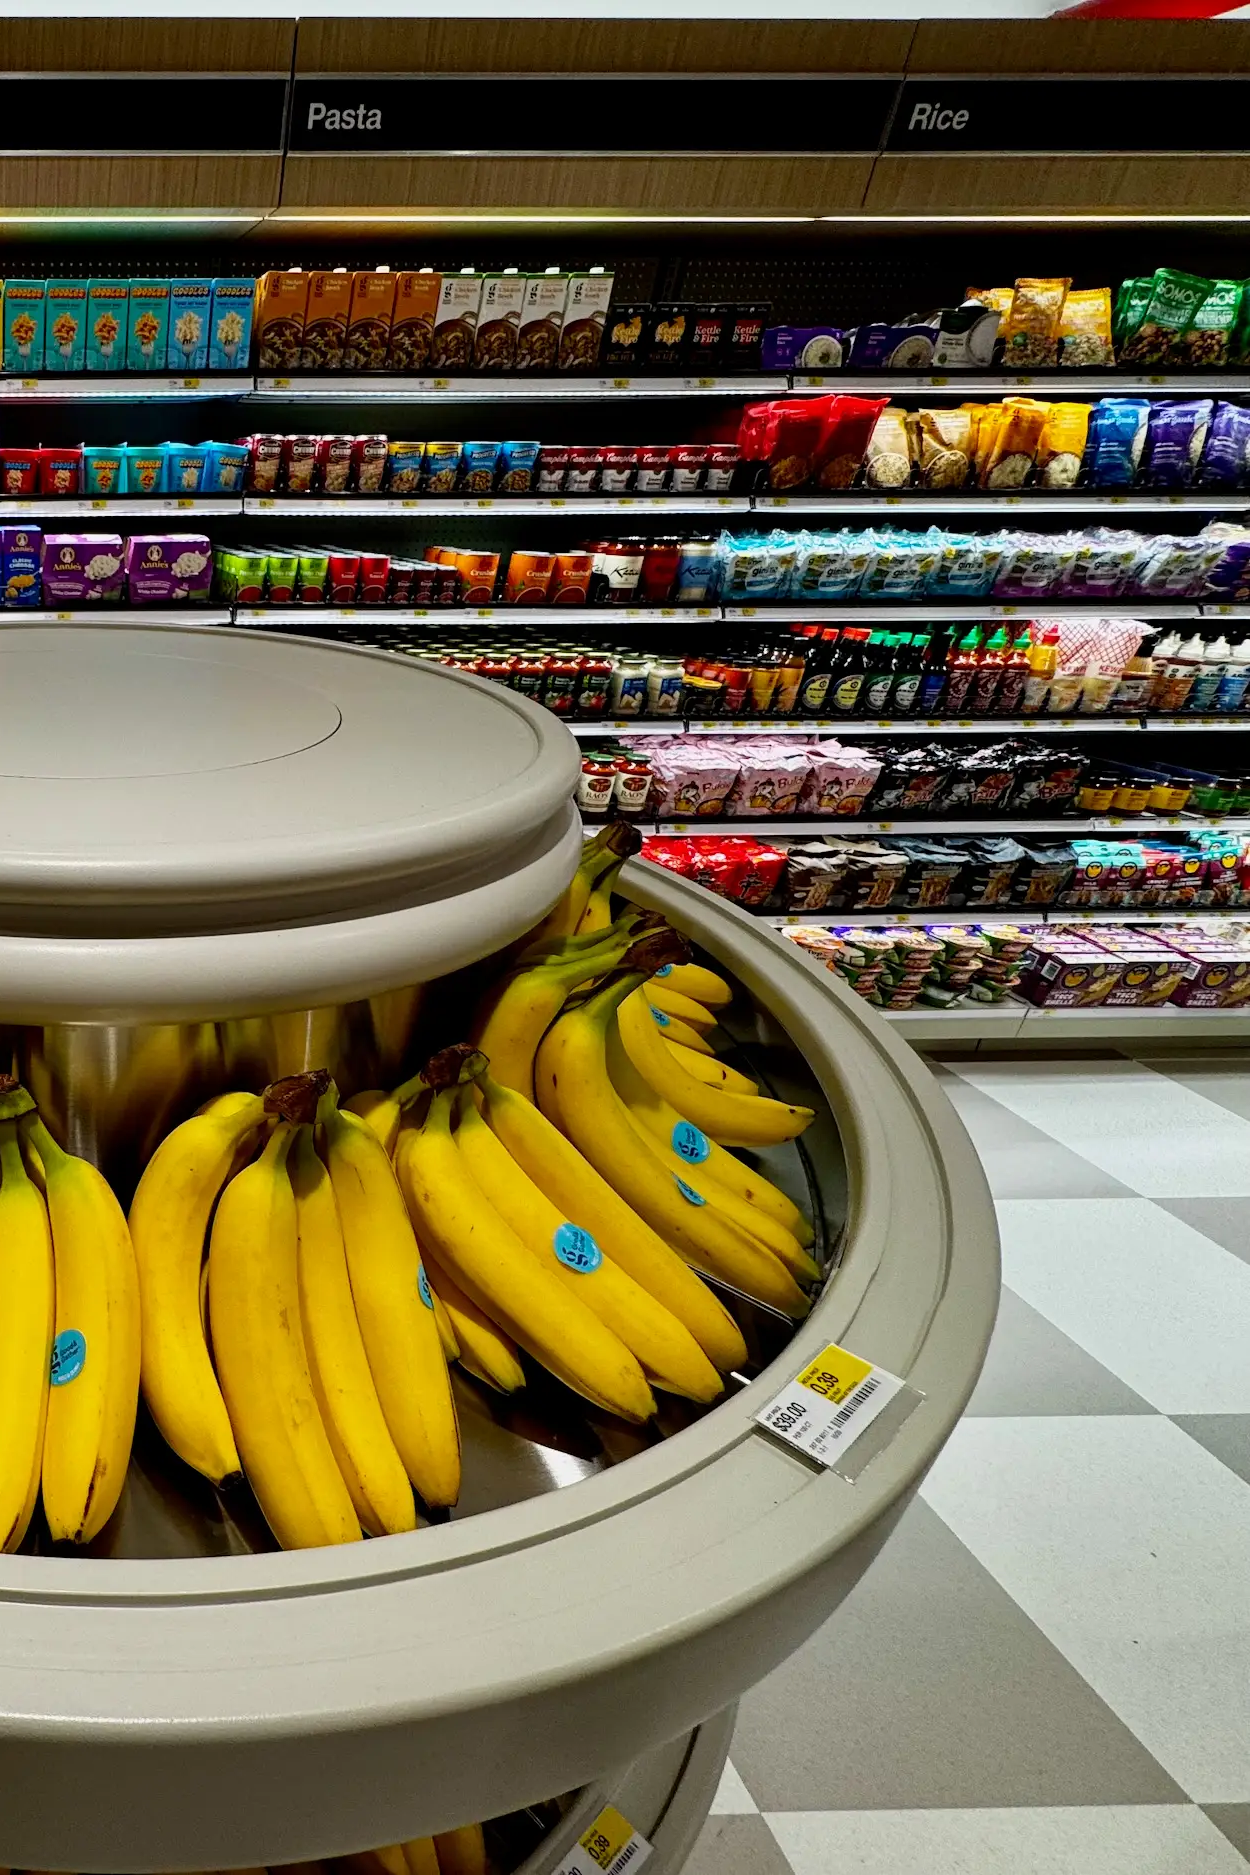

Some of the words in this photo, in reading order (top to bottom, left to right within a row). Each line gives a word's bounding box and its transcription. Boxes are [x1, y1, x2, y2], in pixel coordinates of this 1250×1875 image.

[308, 103, 381, 129] Pasta
[909, 103, 969, 129] Rice
[1203, 291, 1236, 305] MOS
[694, 325, 722, 335] Kettle
[734, 325, 761, 334] Kettle
[700, 335, 720, 343] Fire
[53, 562, 82, 571] Annie's
[140, 561, 169, 570] Annie's
[810, 1372, 839, 1395] 0.39
[764, 1413, 773, 1421] UNIT
[770, 1405, 781, 1414] PRICE
[772, 1402, 807, 1432] $39.00
[588, 1835, 610, 1860] 0.39
